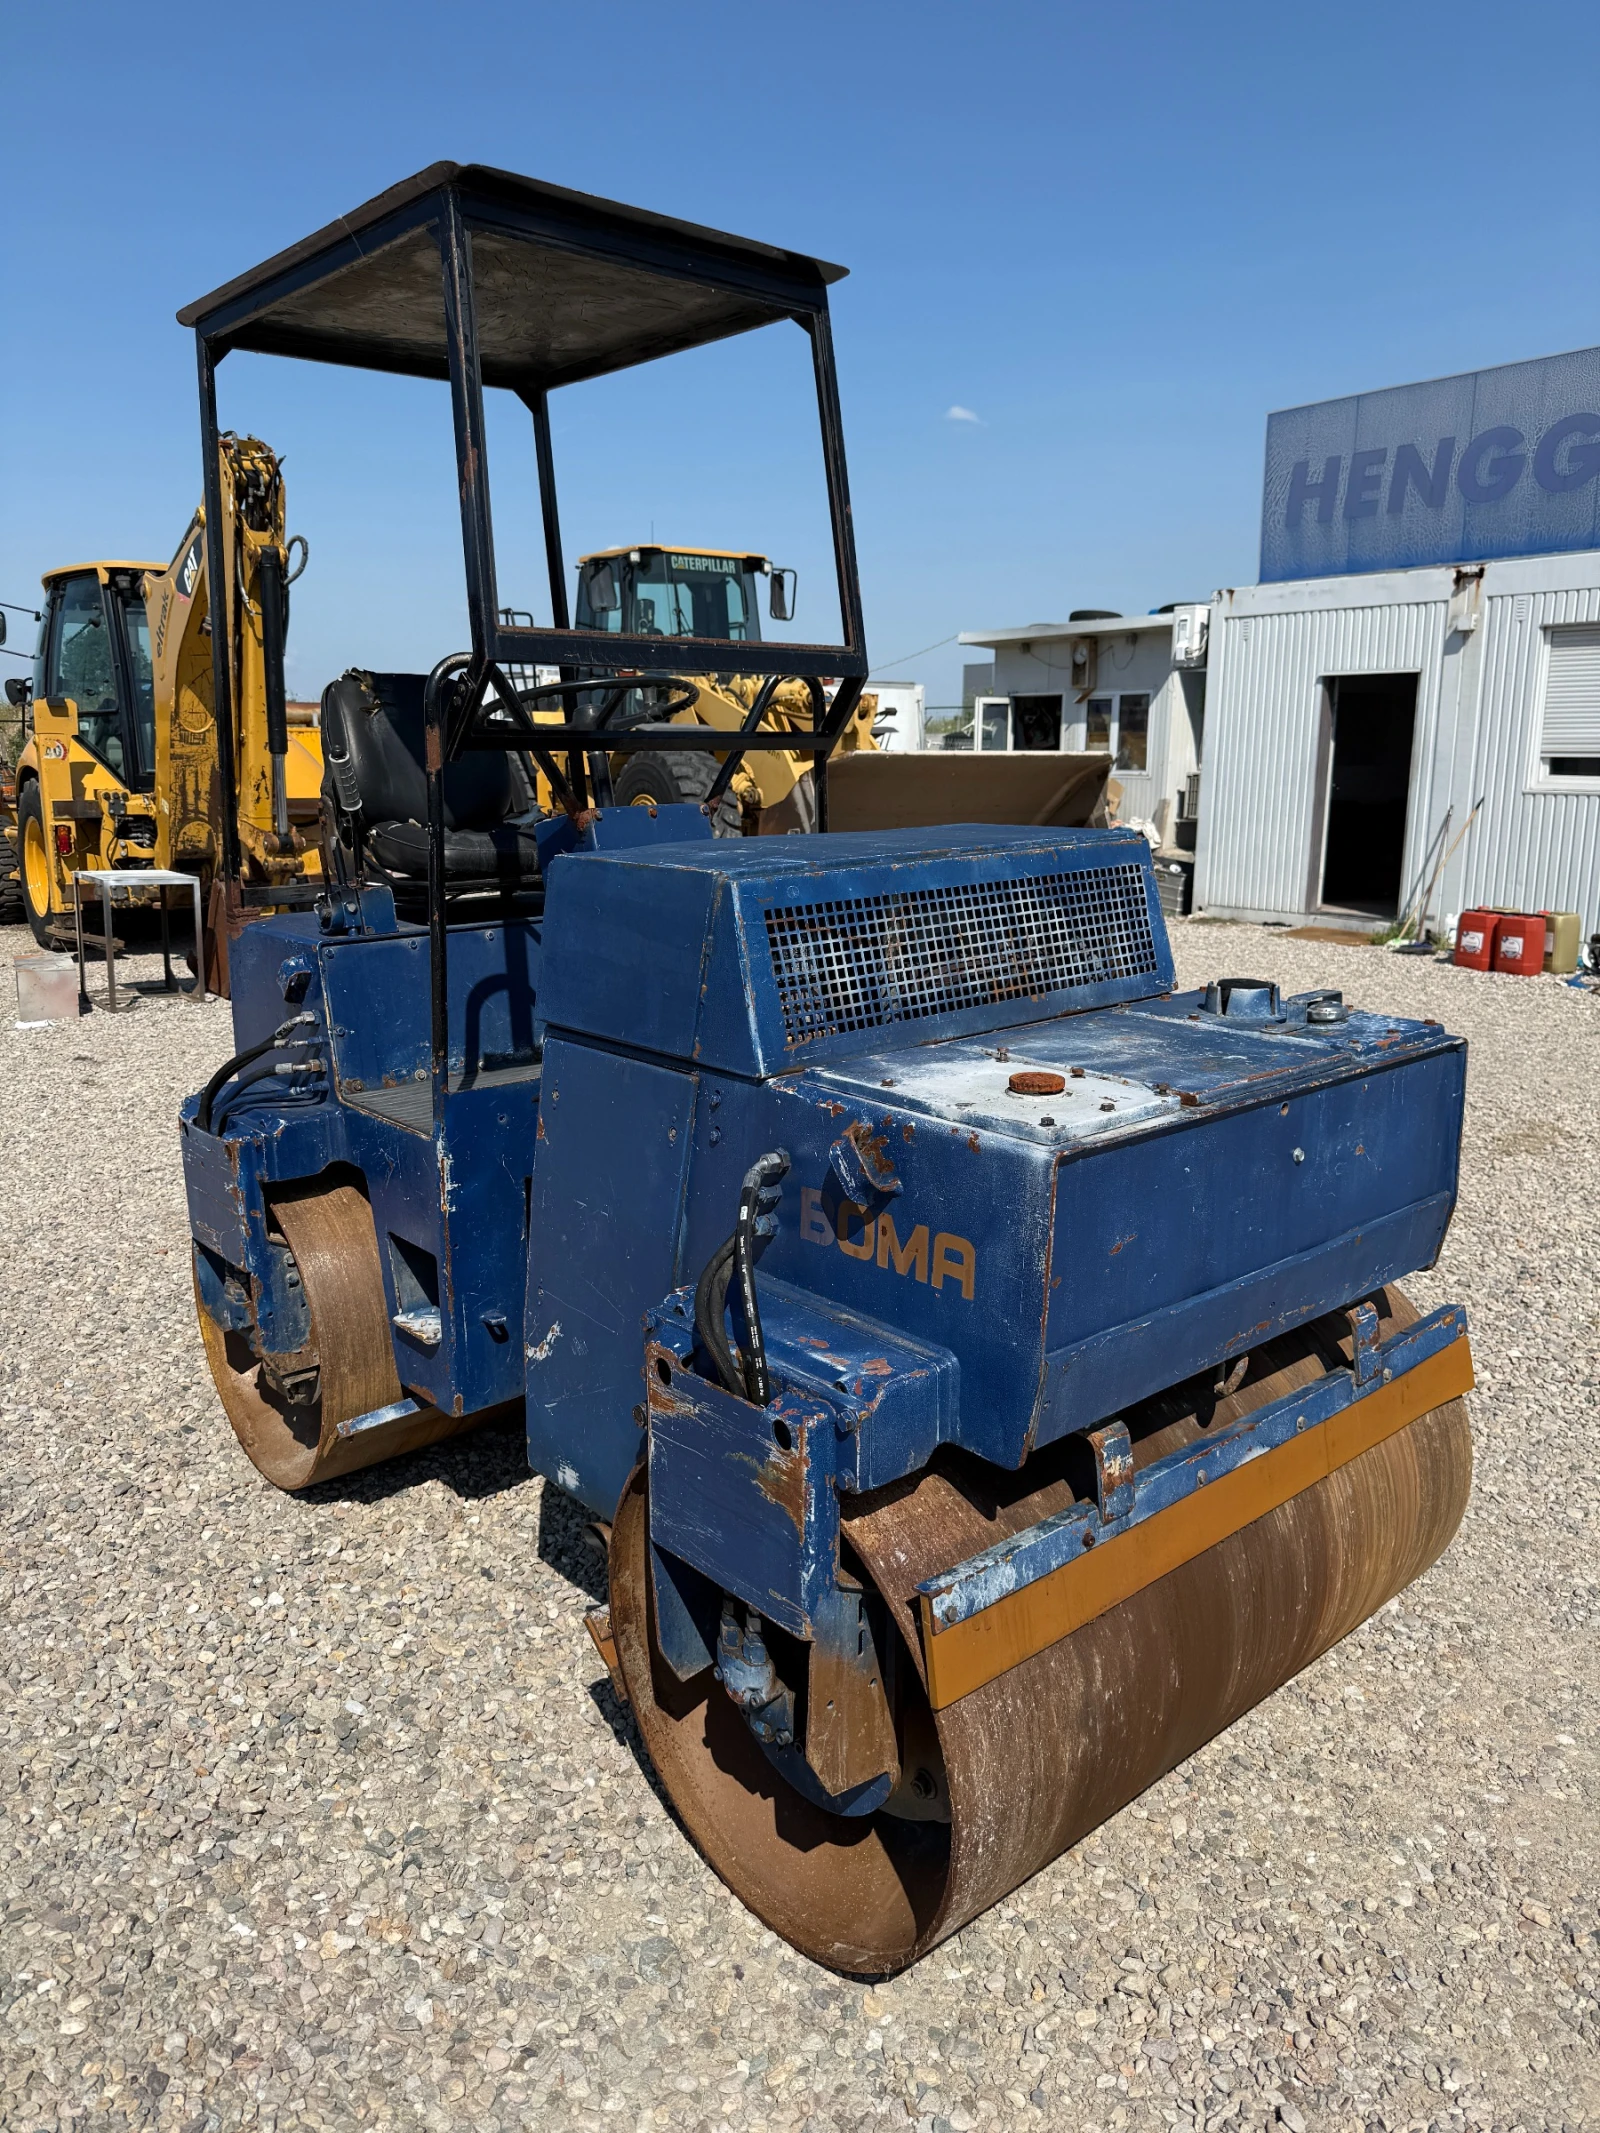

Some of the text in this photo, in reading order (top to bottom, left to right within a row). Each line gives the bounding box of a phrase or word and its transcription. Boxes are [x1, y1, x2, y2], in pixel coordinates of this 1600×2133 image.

[1285, 412, 1600, 527] HENGG
[184, 545, 198, 594] CAT
[671, 555, 736, 574] CATERPILLAR
[156, 588, 169, 658] eltrak
[801, 1187, 976, 1301] BOMA
